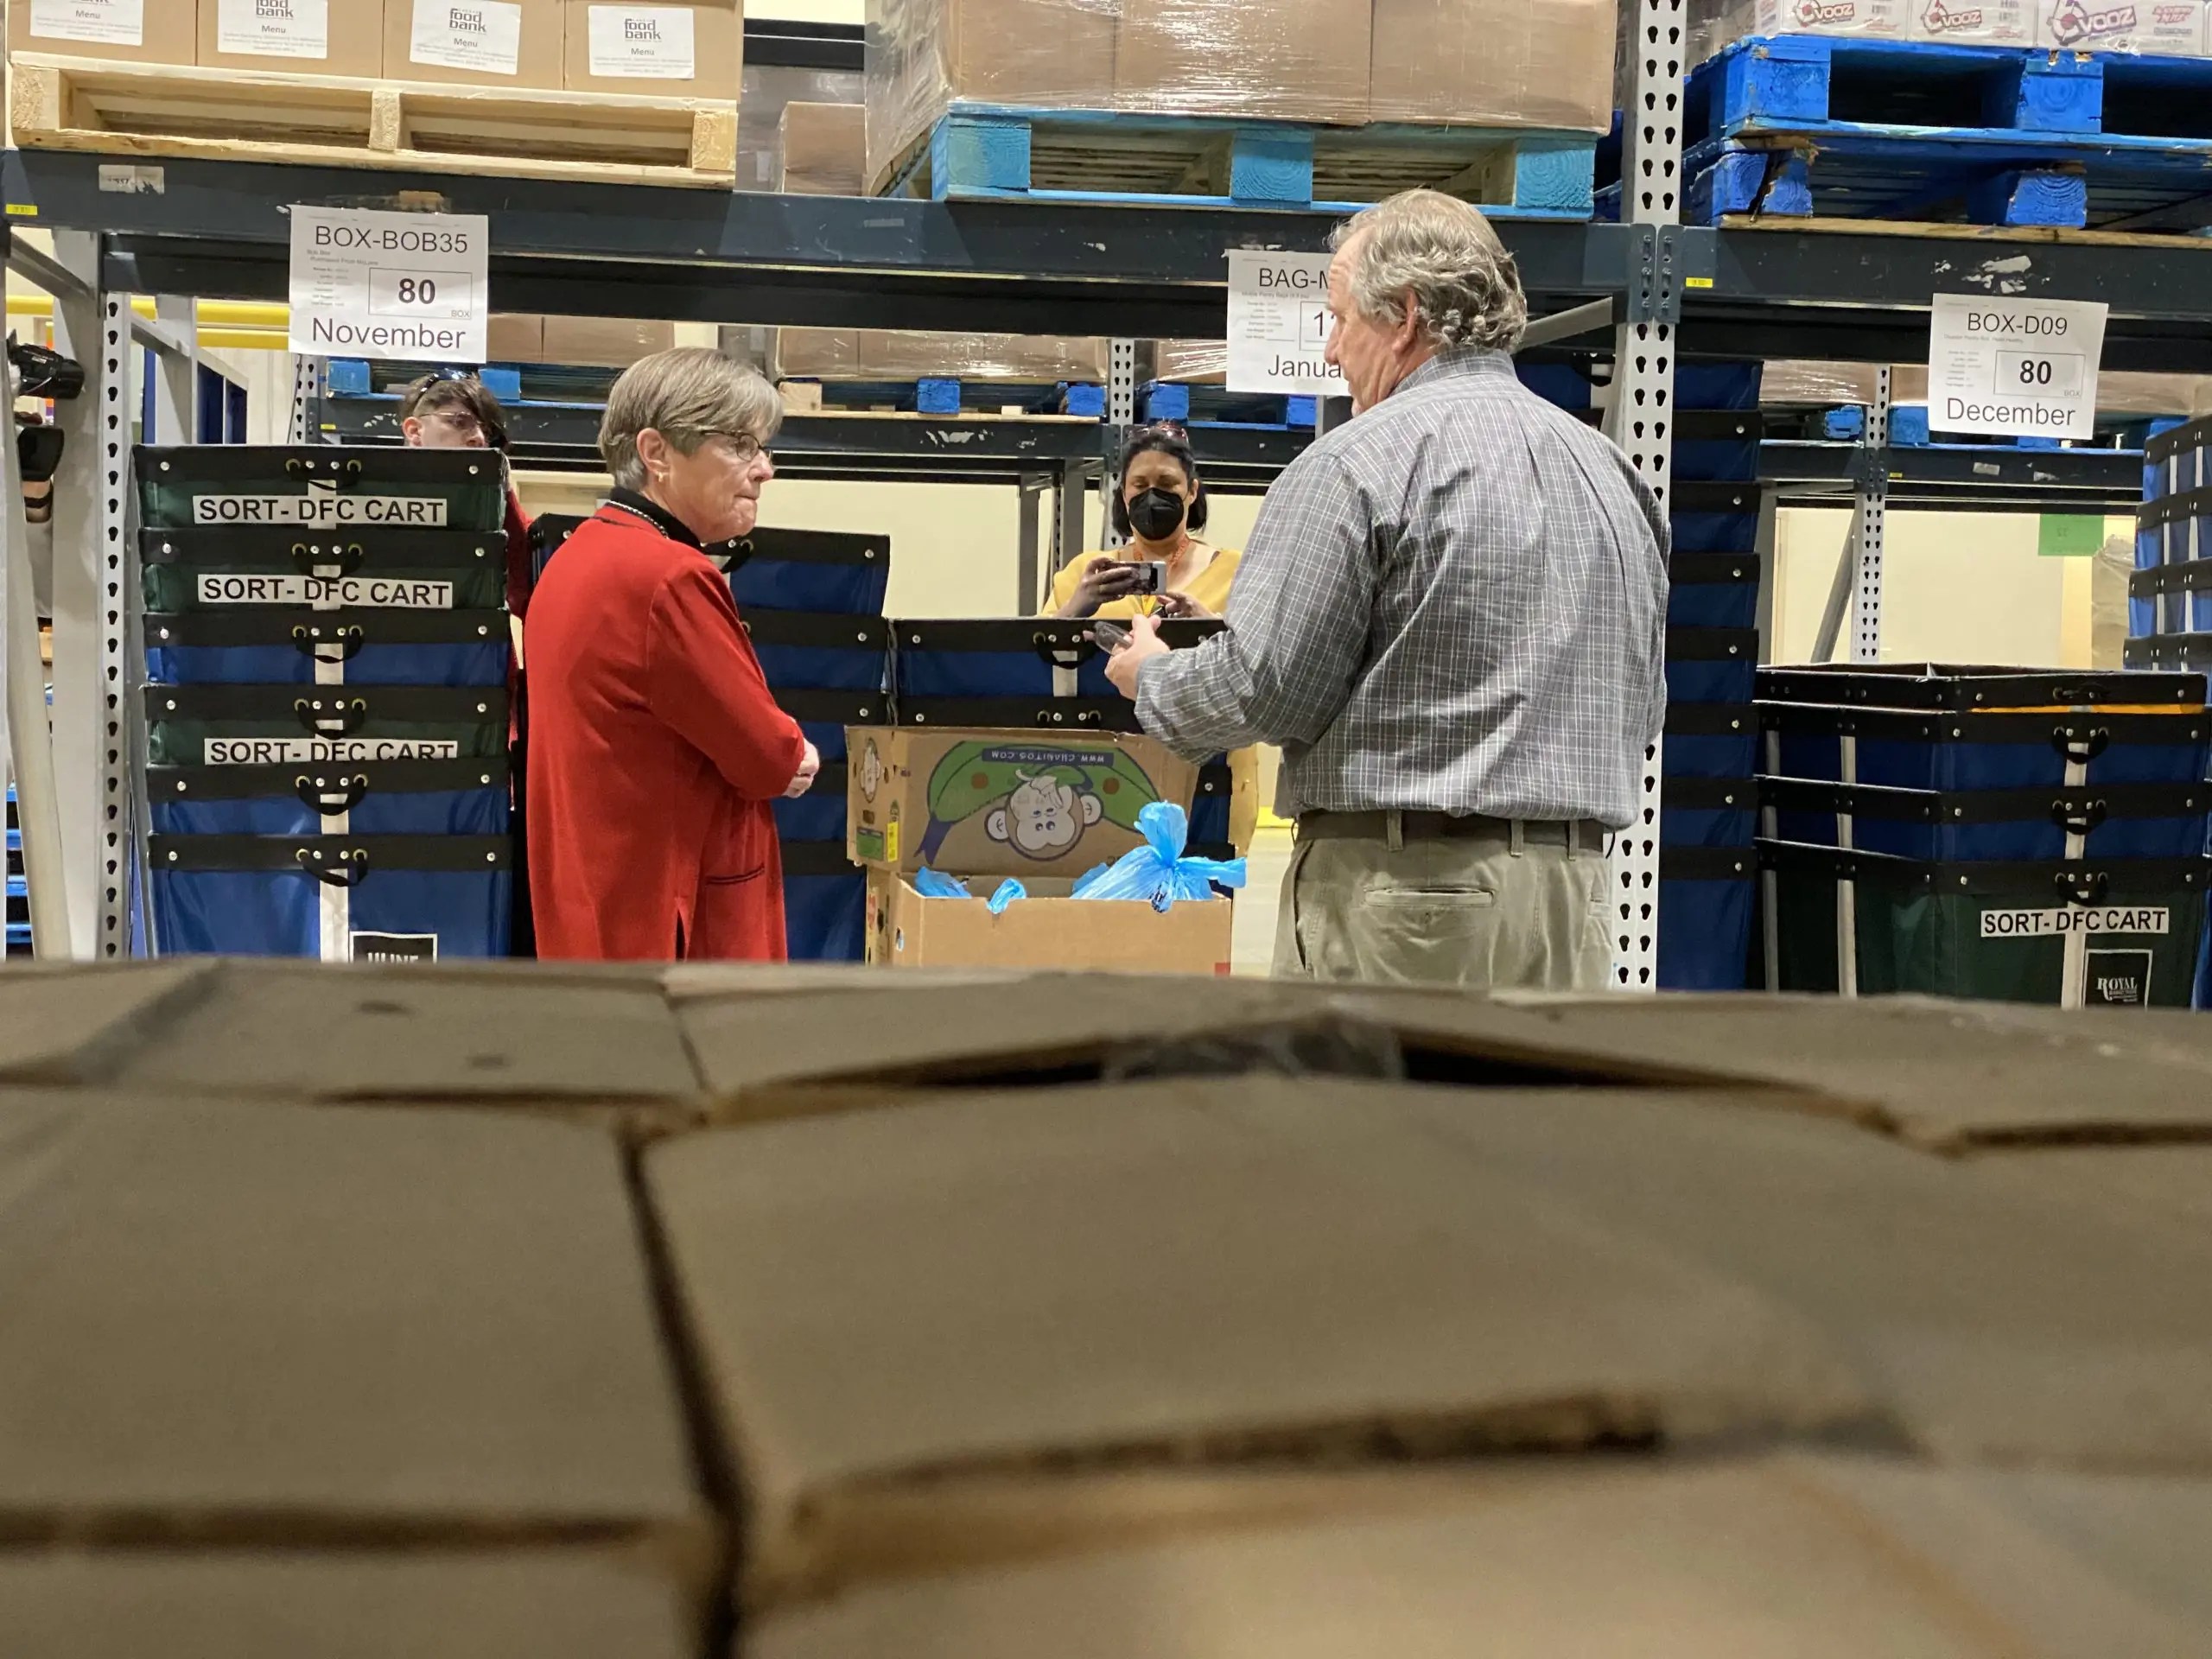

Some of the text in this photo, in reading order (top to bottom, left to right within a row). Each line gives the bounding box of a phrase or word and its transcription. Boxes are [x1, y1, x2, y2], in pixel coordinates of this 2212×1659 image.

[75, 10, 101, 19] Menu
[256, 7, 294, 17] bank
[450, 8, 482, 22] food
[261, 25, 287, 34] Menu
[449, 19, 486, 33] bank
[625, 18, 656, 30] food
[625, 30, 662, 40] bank
[454, 37, 479, 48] Menu
[315, 226, 468, 253] BOX-BOB35
[398, 278, 436, 304] 80
[451, 309, 470, 318] BOX
[1967, 313, 2068, 335] BOX-D09
[312, 317, 467, 349] November
[2019, 359, 2052, 385] 80
[1947, 397, 2076, 426] December
[200, 499, 443, 522] SORT- DFC CART
[204, 578, 449, 606] SORT- DFC CART
[210, 741, 454, 763] SORT- DFC CART
[1984, 909, 2167, 933] SORT- DFC CART
[2096, 976, 2138, 1001] ROYAL
